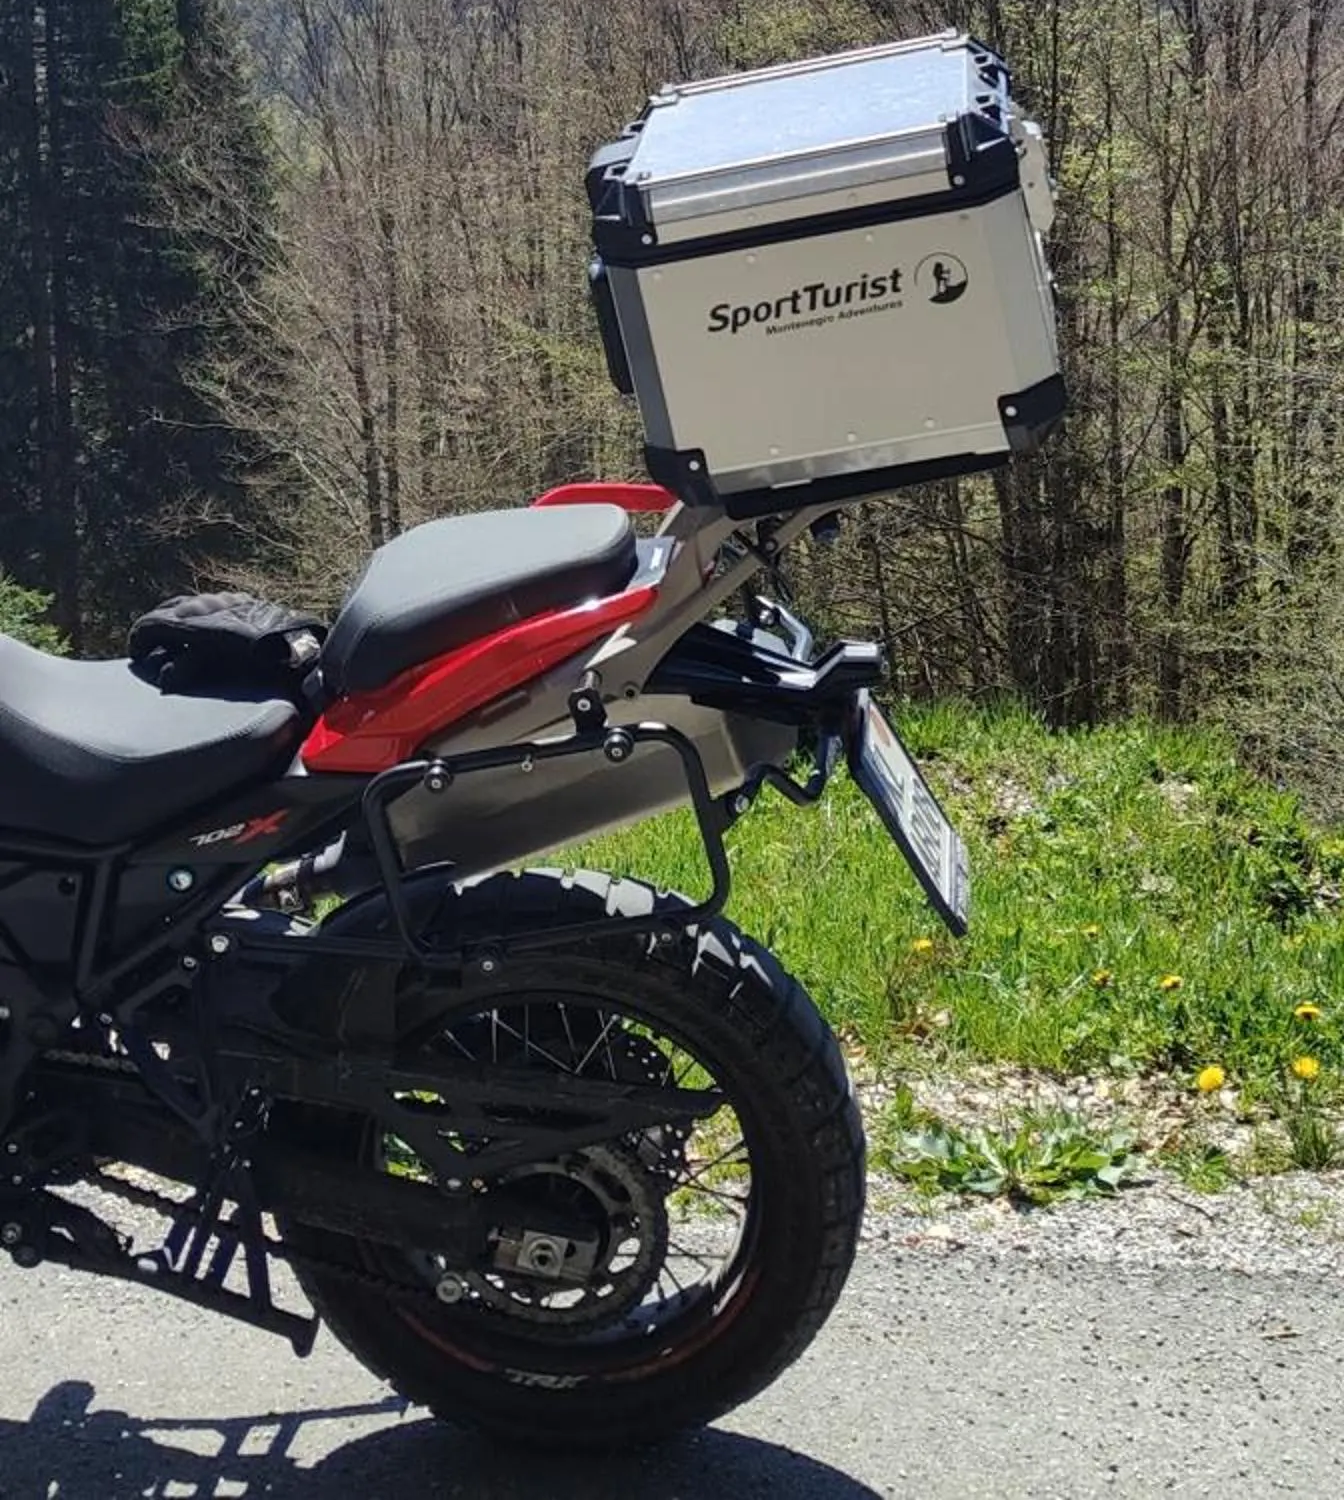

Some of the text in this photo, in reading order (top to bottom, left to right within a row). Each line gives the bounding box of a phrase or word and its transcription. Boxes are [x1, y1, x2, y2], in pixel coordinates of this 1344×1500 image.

[707, 267, 903, 334] SportTurist
[765, 299, 904, 336] Montenegro Adventures
[189, 809, 290, 846] 702X
